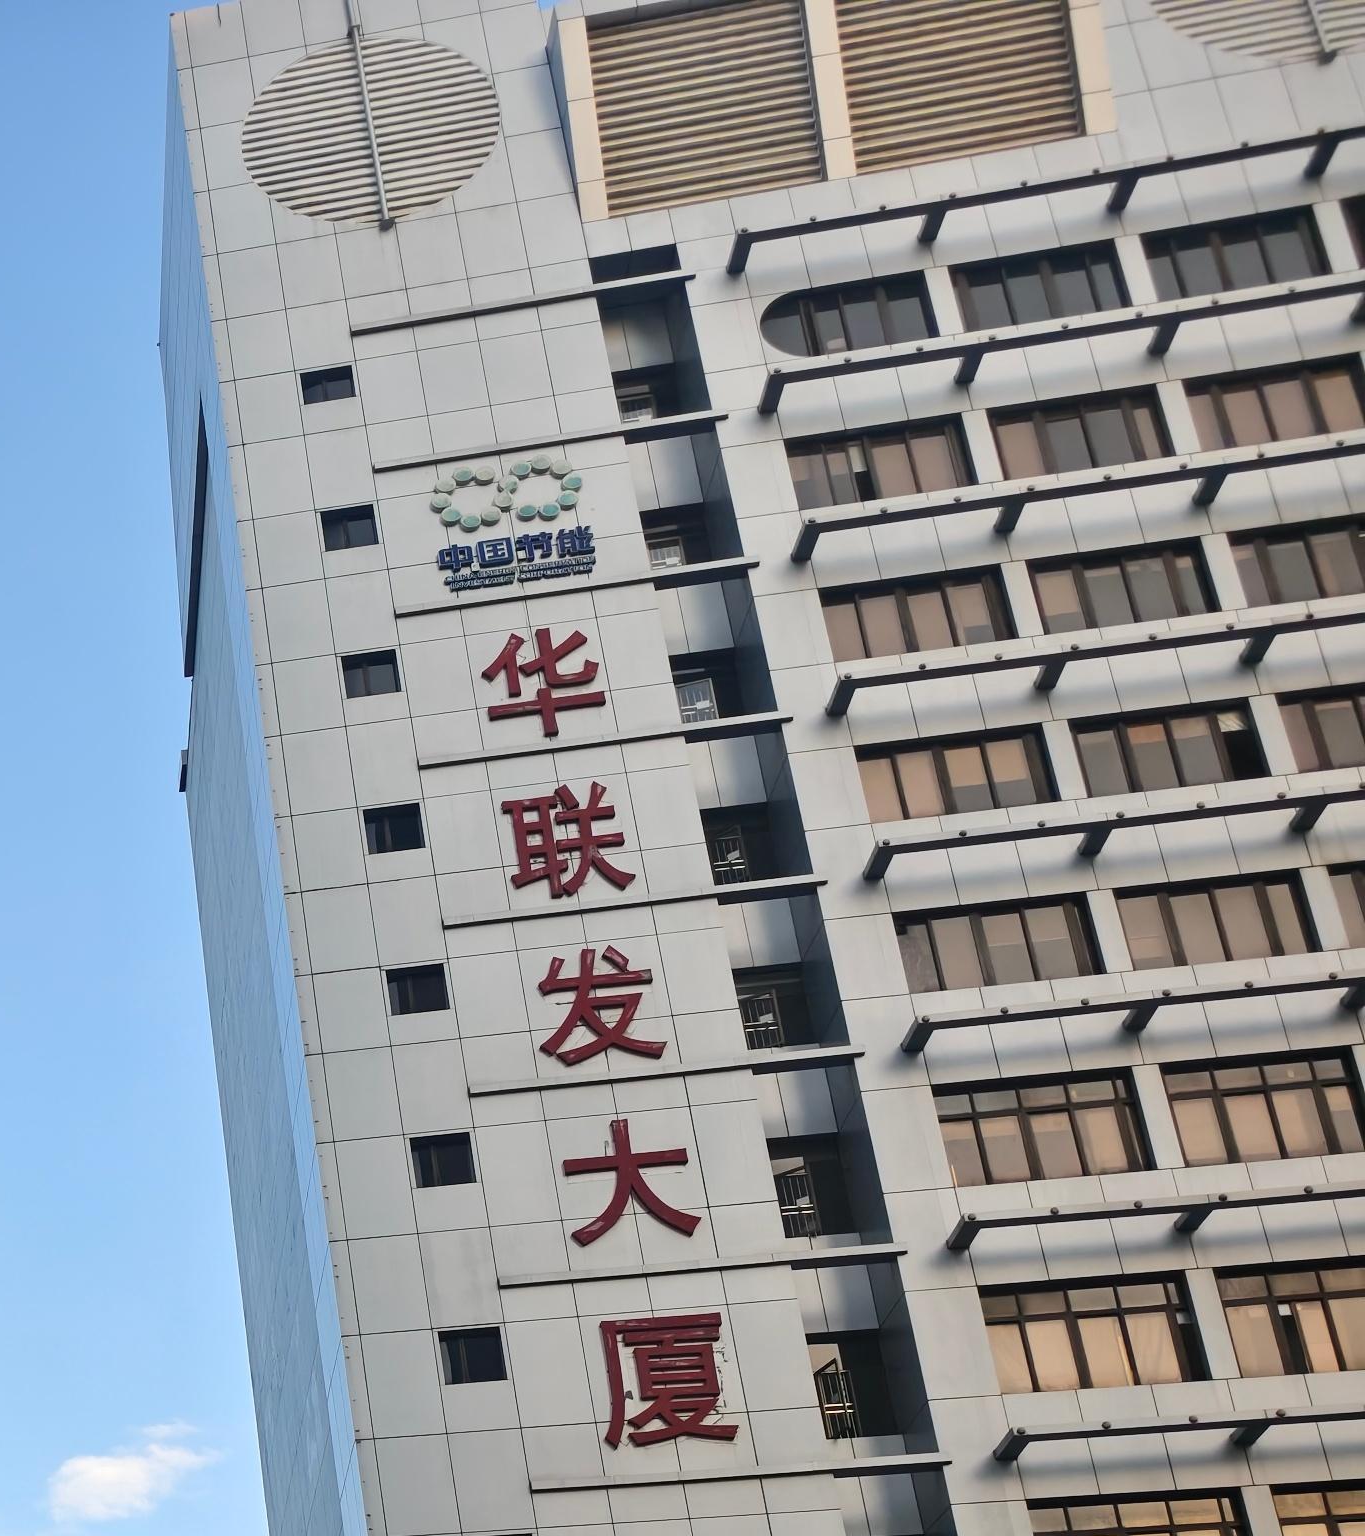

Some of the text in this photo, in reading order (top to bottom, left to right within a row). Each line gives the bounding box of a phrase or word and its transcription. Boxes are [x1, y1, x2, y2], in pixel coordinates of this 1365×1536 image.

[438, 526, 596, 572] 中国节能
[482, 628, 739, 1449] 华联发大厦
